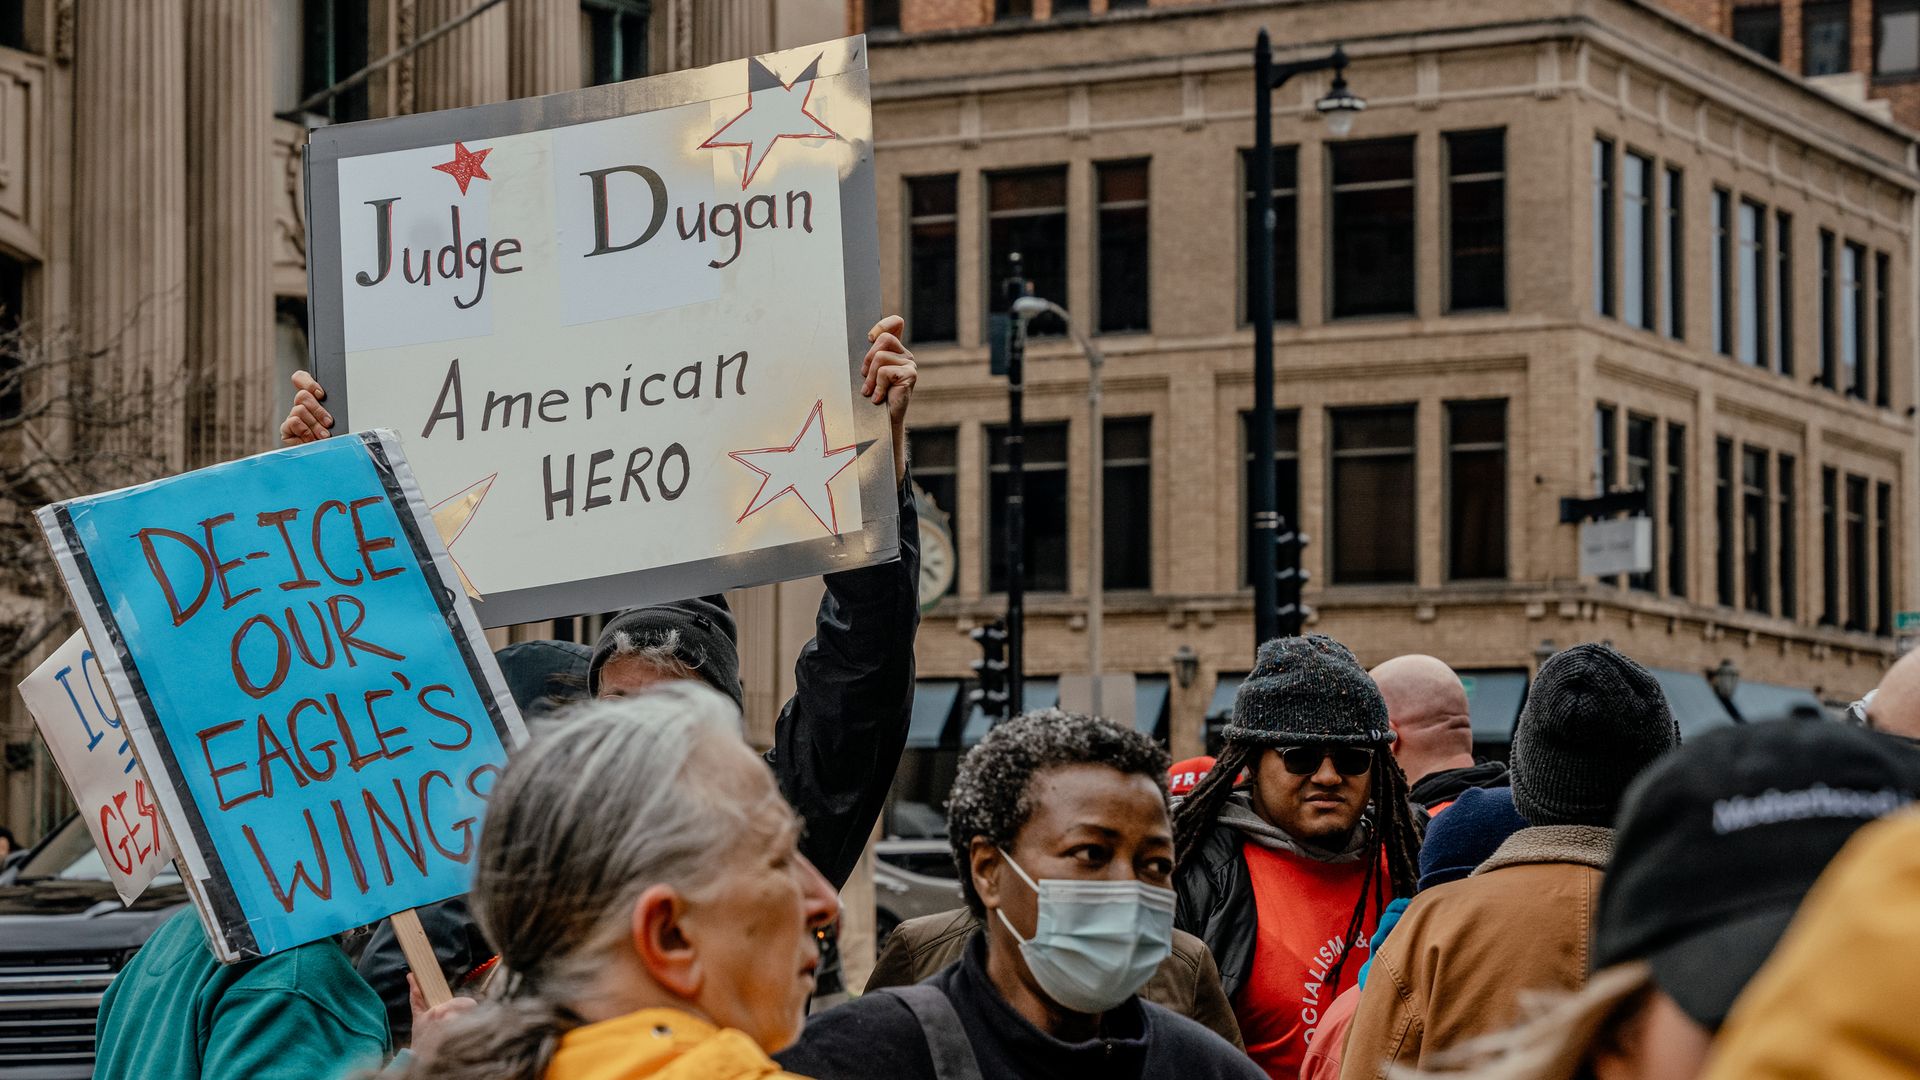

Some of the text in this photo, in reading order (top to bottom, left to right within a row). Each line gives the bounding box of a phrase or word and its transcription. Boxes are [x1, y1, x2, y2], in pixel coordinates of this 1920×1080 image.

[355, 164, 813, 309] Judge Dugan
[421, 349, 749, 441] American
[541, 441, 691, 521] HERO
[130, 495, 407, 627] DE-ICE
[231, 594, 406, 699] OUR
[195, 671, 473, 812] EAGLE'S
